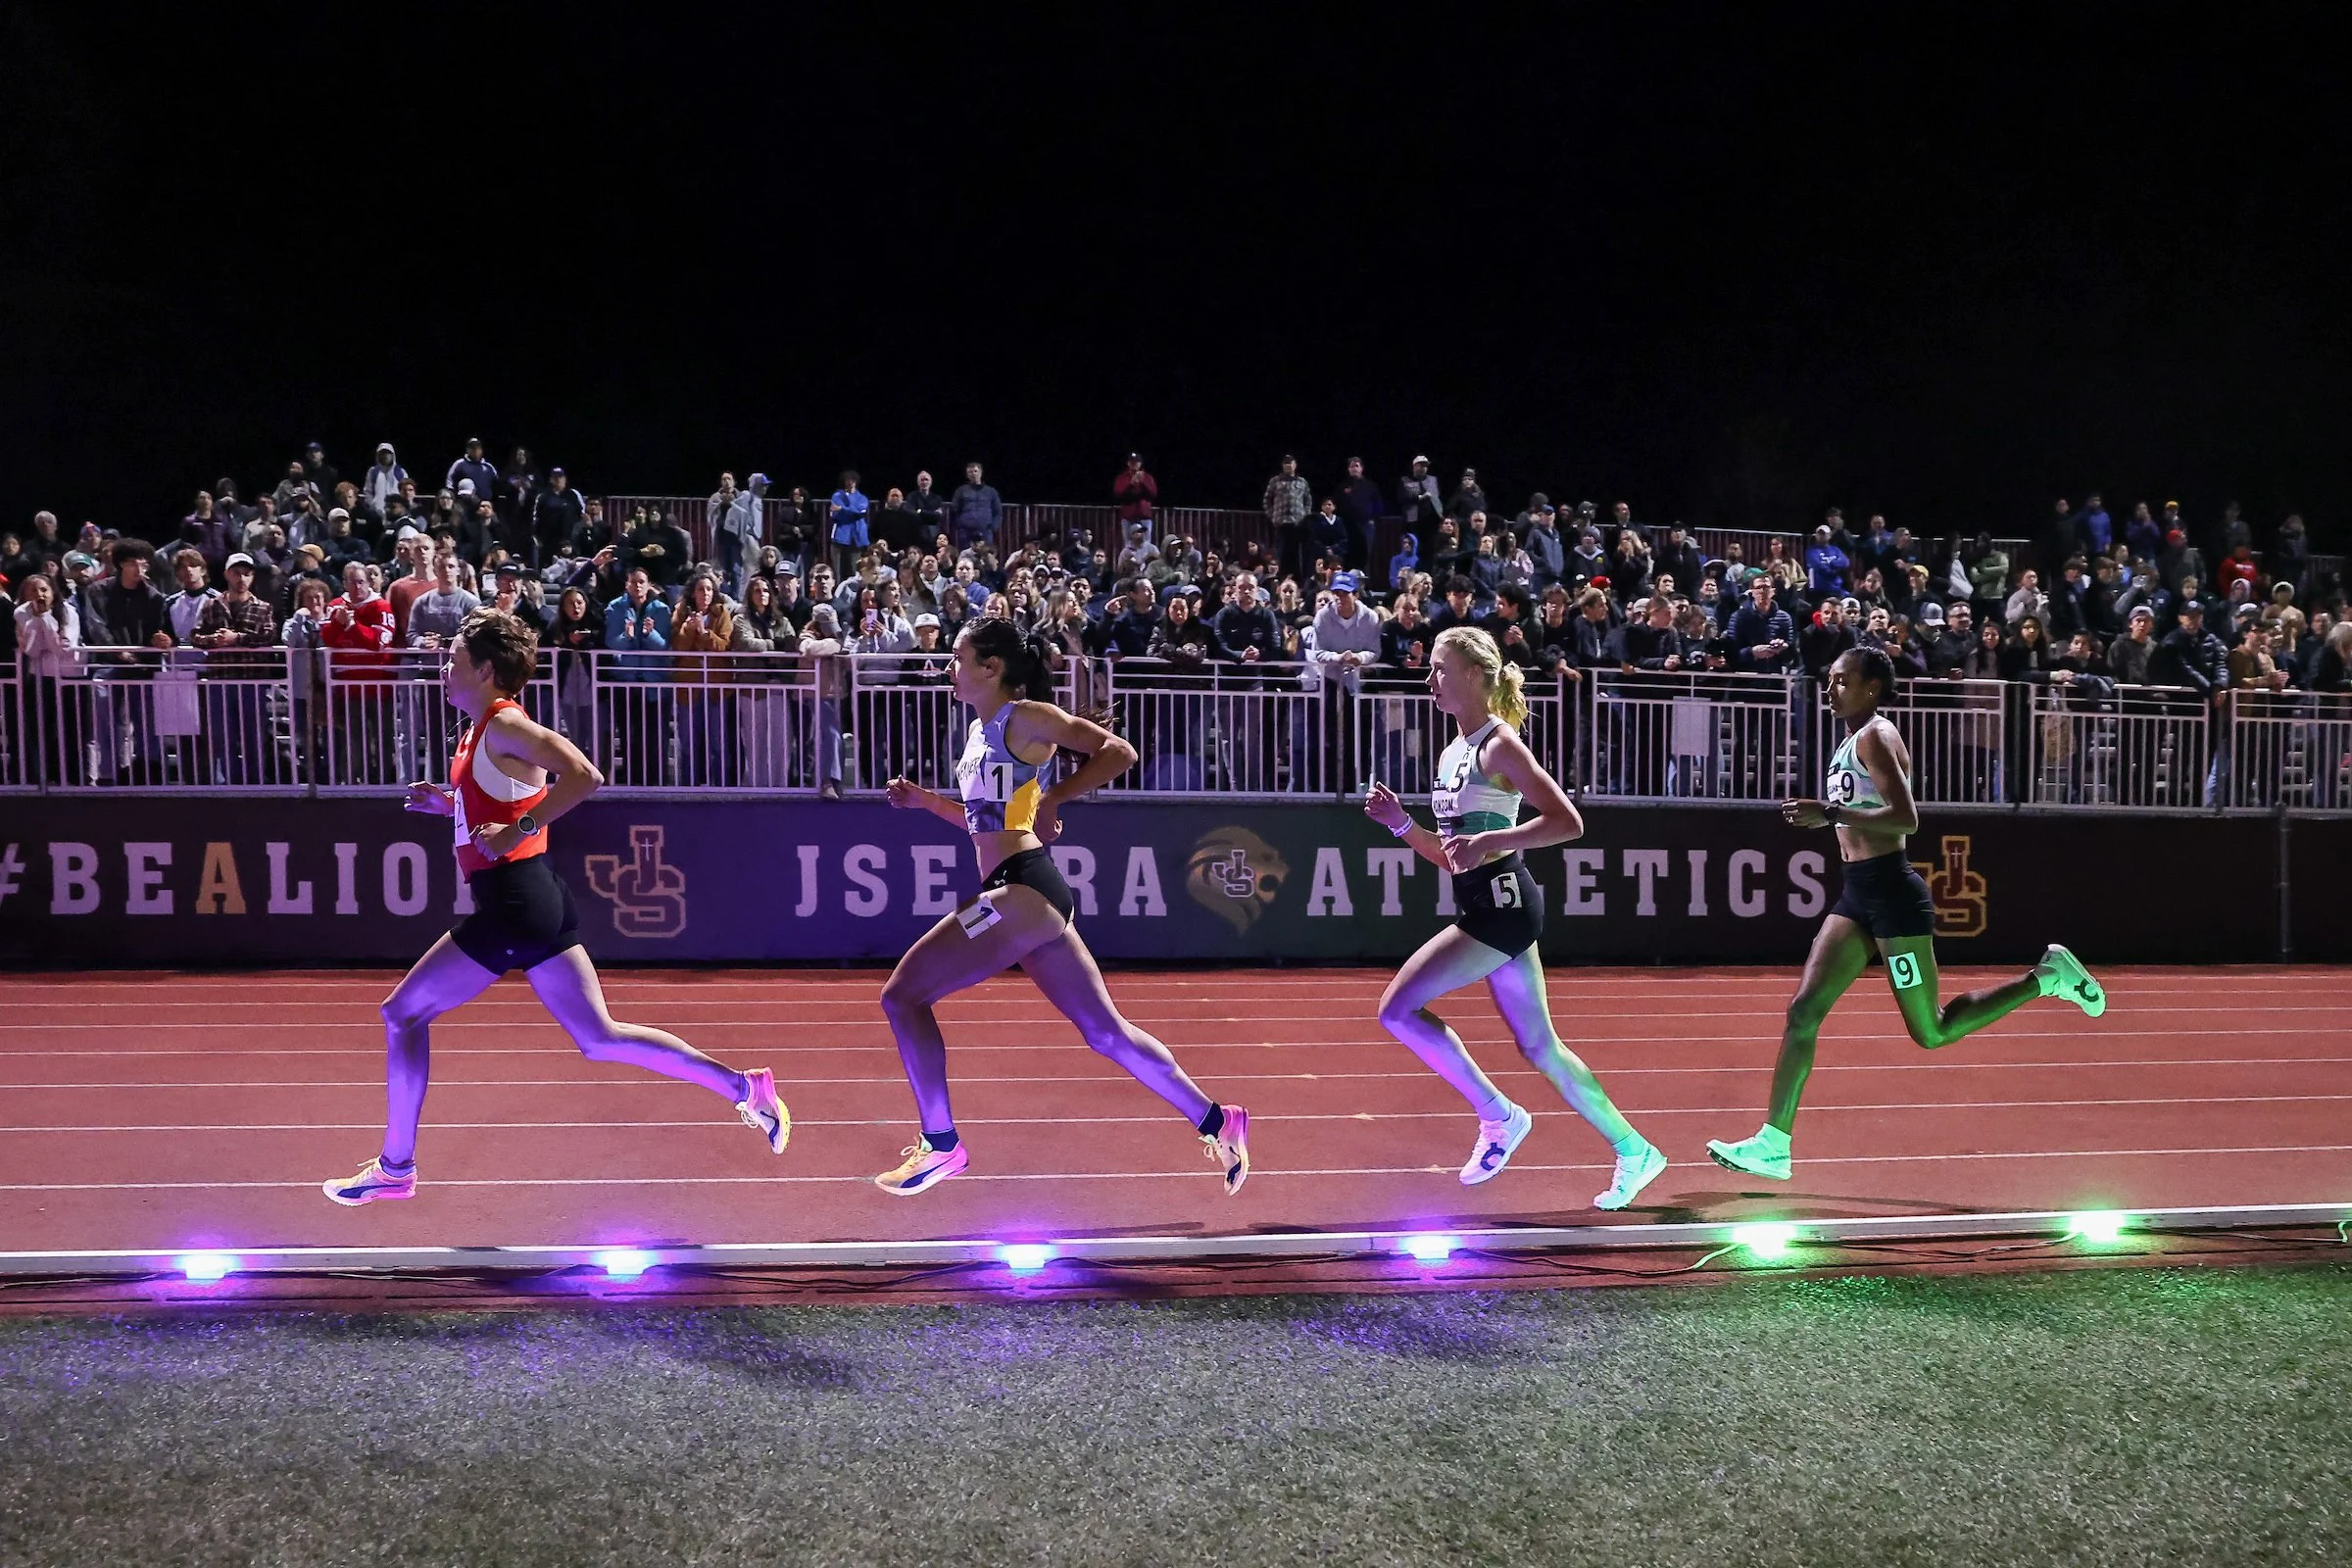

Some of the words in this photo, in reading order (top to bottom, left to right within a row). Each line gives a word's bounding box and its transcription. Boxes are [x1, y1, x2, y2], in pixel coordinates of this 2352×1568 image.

[991, 764, 1004, 800] 1
[1450, 762, 1468, 793] 5
[1840, 771, 1855, 803] 9
[795, 844, 1167, 917] JSERA
[1306, 847, 1827, 918] ATETICS
[1497, 875, 1516, 908] 5
[1894, 956, 1914, 986] 9
